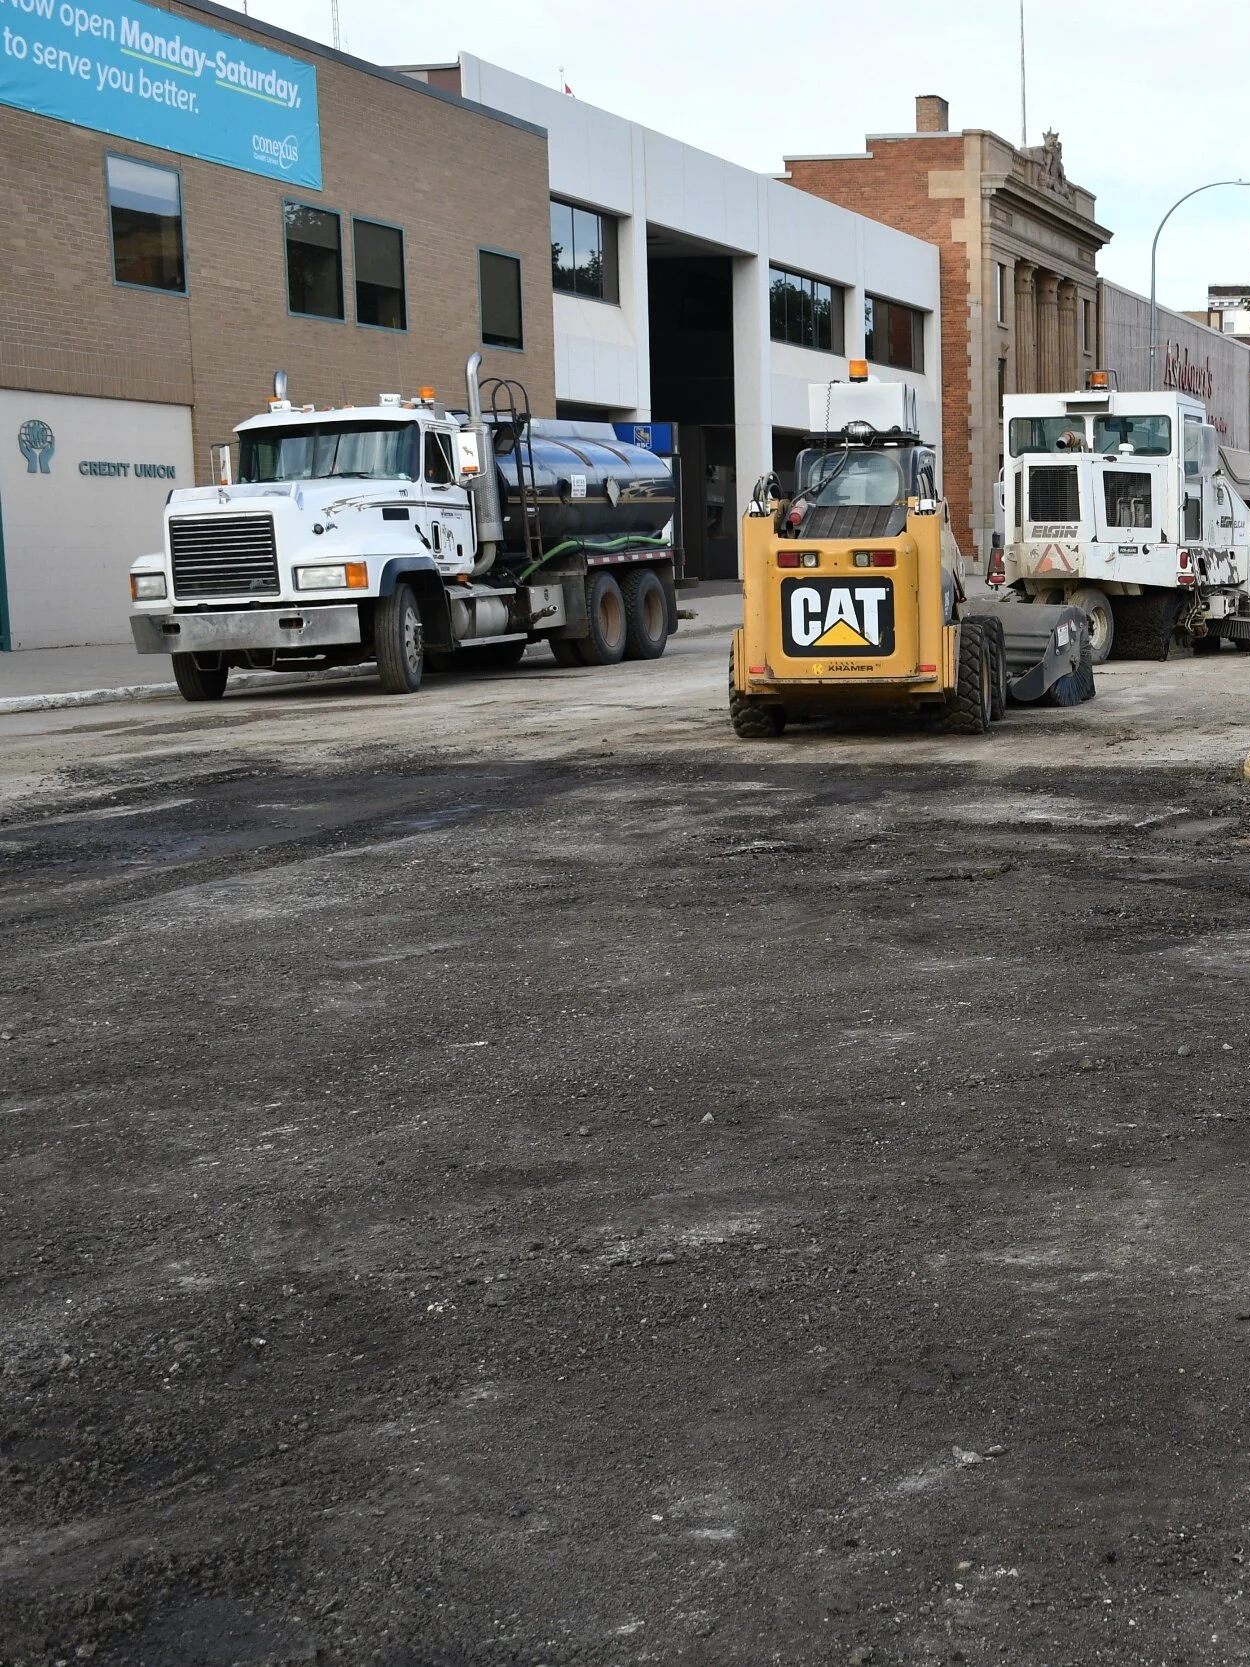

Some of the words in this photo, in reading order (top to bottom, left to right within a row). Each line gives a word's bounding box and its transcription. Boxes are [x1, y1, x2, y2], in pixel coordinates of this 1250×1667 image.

[60, 4, 115, 41] open
[3, 26, 27, 59] to
[33, 42, 91, 80] serve
[96, 62, 133, 91] you
[139, 68, 199, 113] better.
[79, 461, 130, 477] CREDIT
[134, 463, 176, 479] UNION
[1031, 525, 1079, 538] ELGIN
[790, 587, 886, 647] CAT
